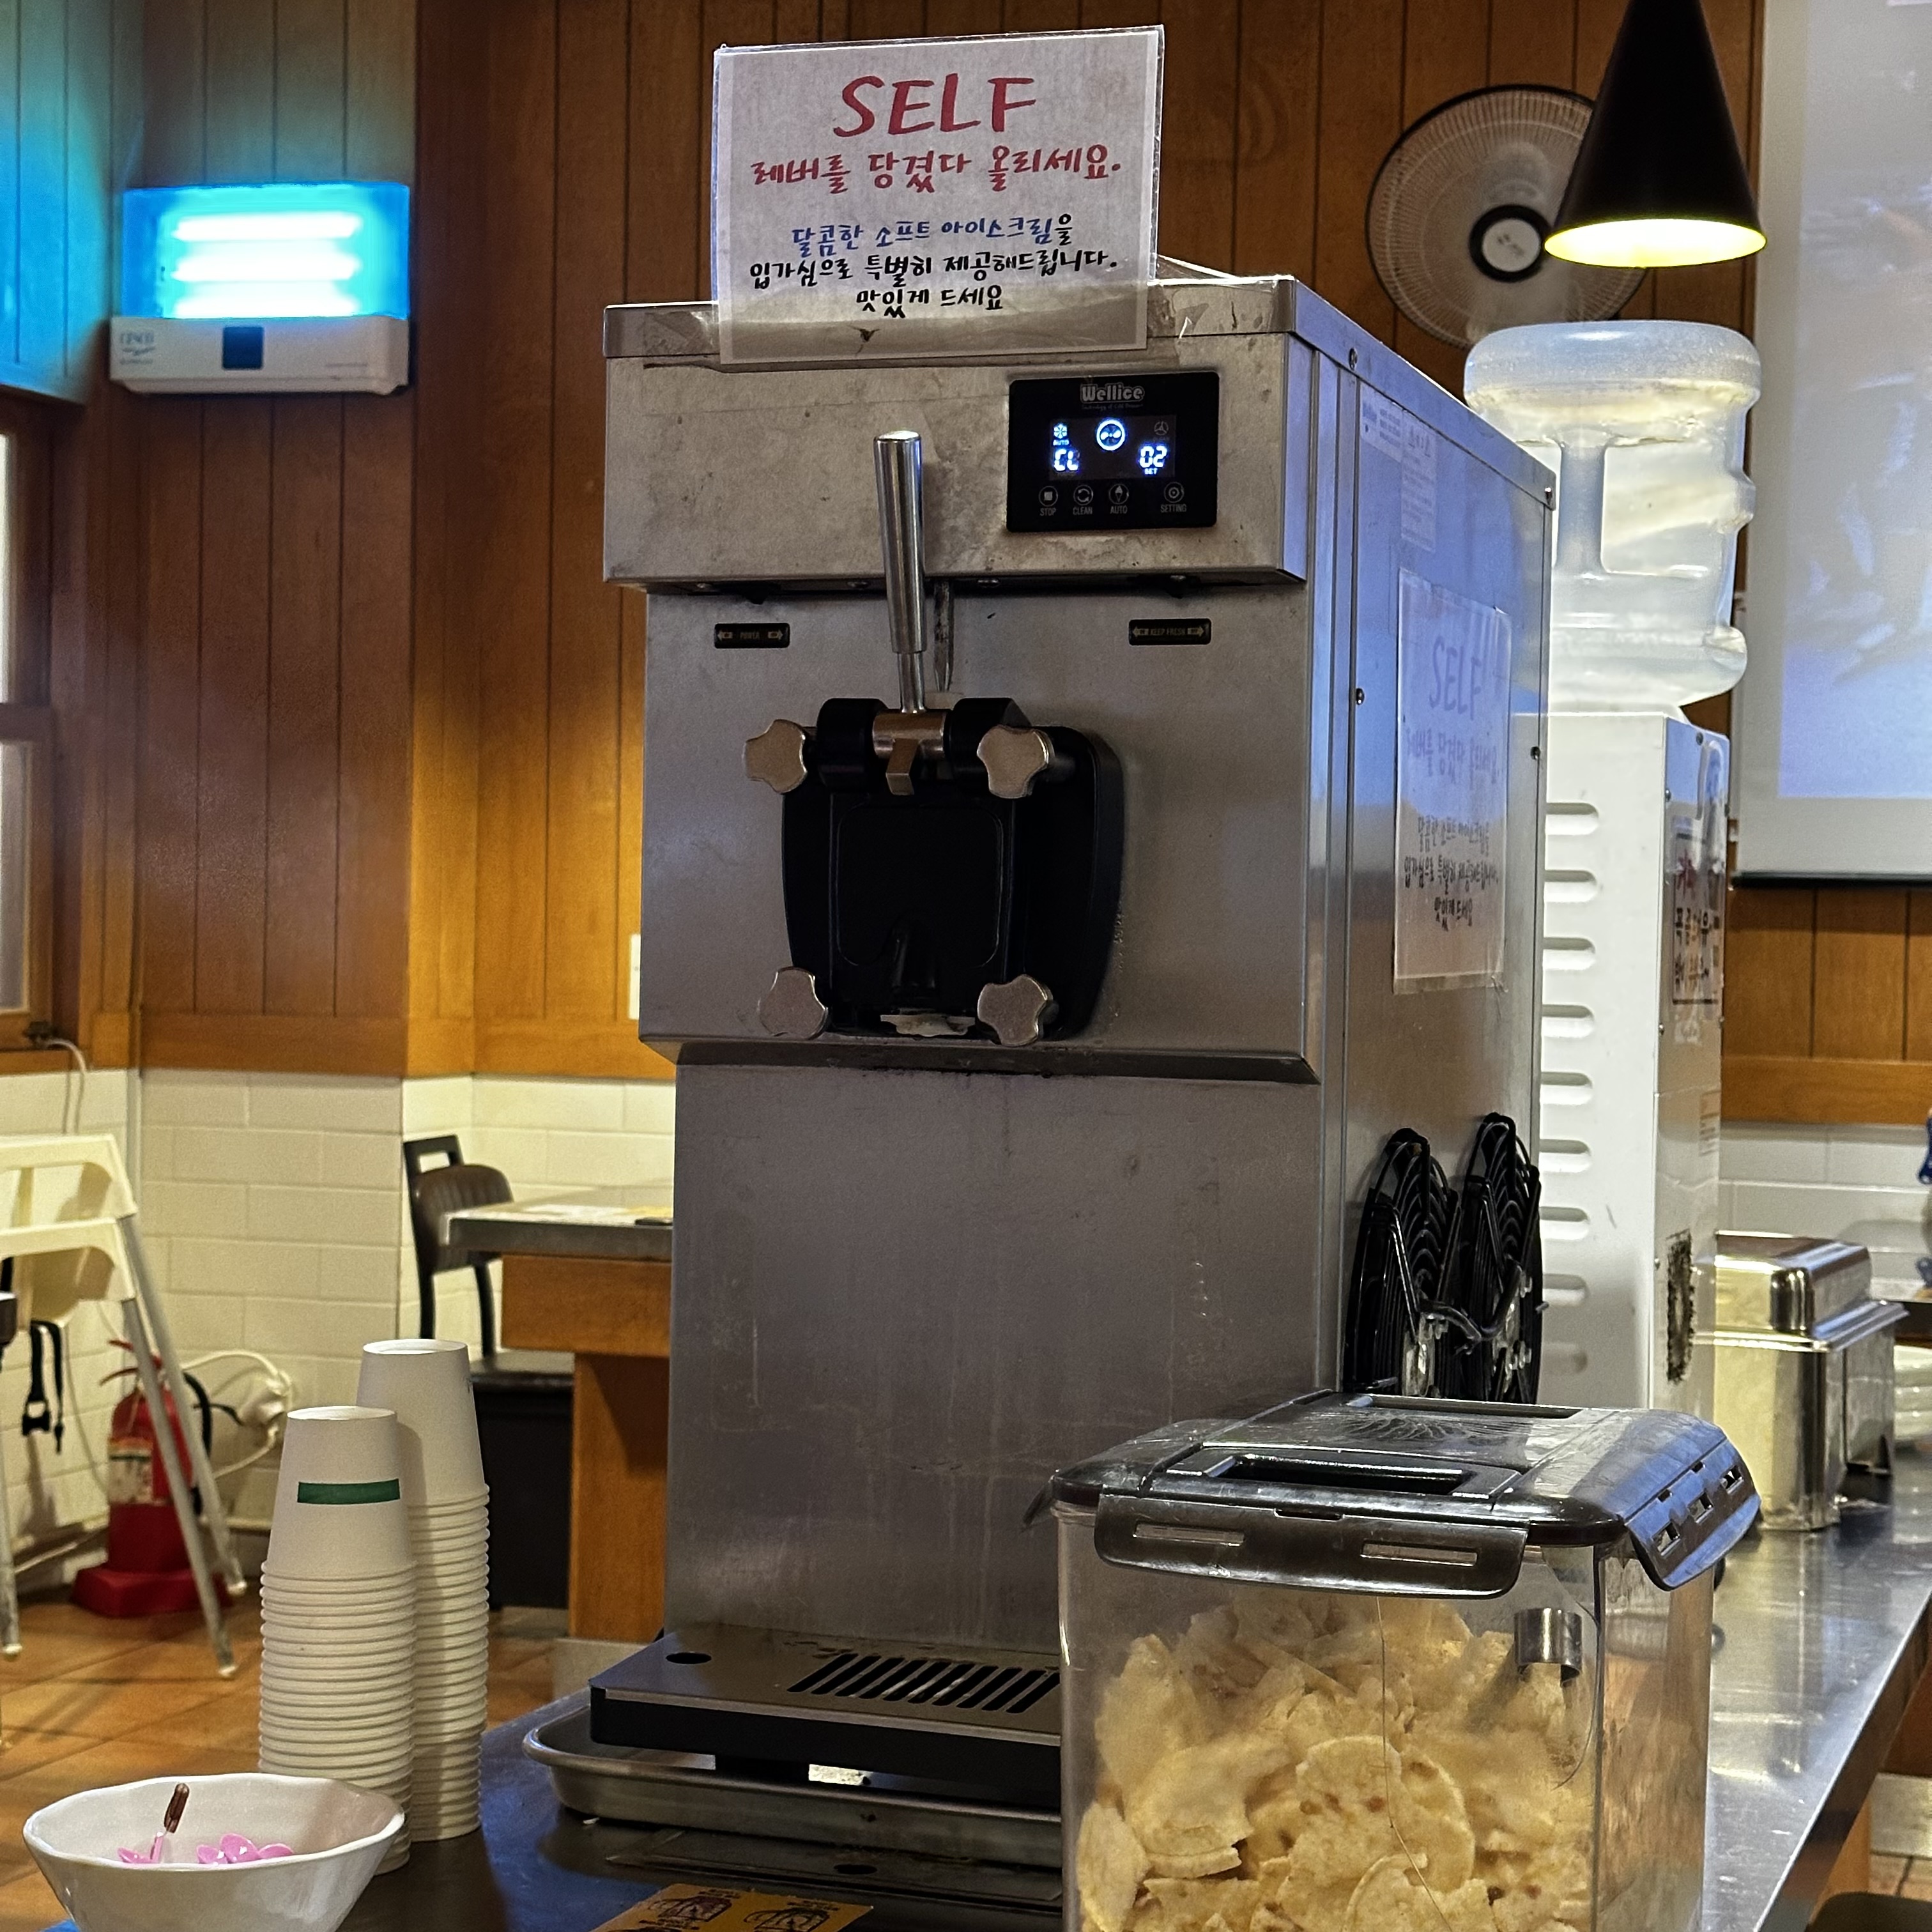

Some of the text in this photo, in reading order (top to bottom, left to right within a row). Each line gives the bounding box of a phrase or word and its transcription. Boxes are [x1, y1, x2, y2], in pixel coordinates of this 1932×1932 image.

[834, 73, 1036, 137] SELF
[751, 144, 1121, 194] 레버를 당겼다 올리세요.
[792, 213, 1073, 257] 달콤한 소프트 아이스크림을
[749, 249, 1117, 289] 입가심으로 특별히 제공해드립니다.
[856, 284, 1004, 319] 맛있게 드세요
[1081, 383, 1144, 403] Wellice
[1139, 445, 1168, 468] 02
[1039, 507, 1057, 516] STOP
[1073, 506, 1093, 515] CLEAN
[1110, 505, 1128, 514] AUTO
[1160, 503, 1187, 512] SETTING
[1429, 636, 1482, 721] SELF
